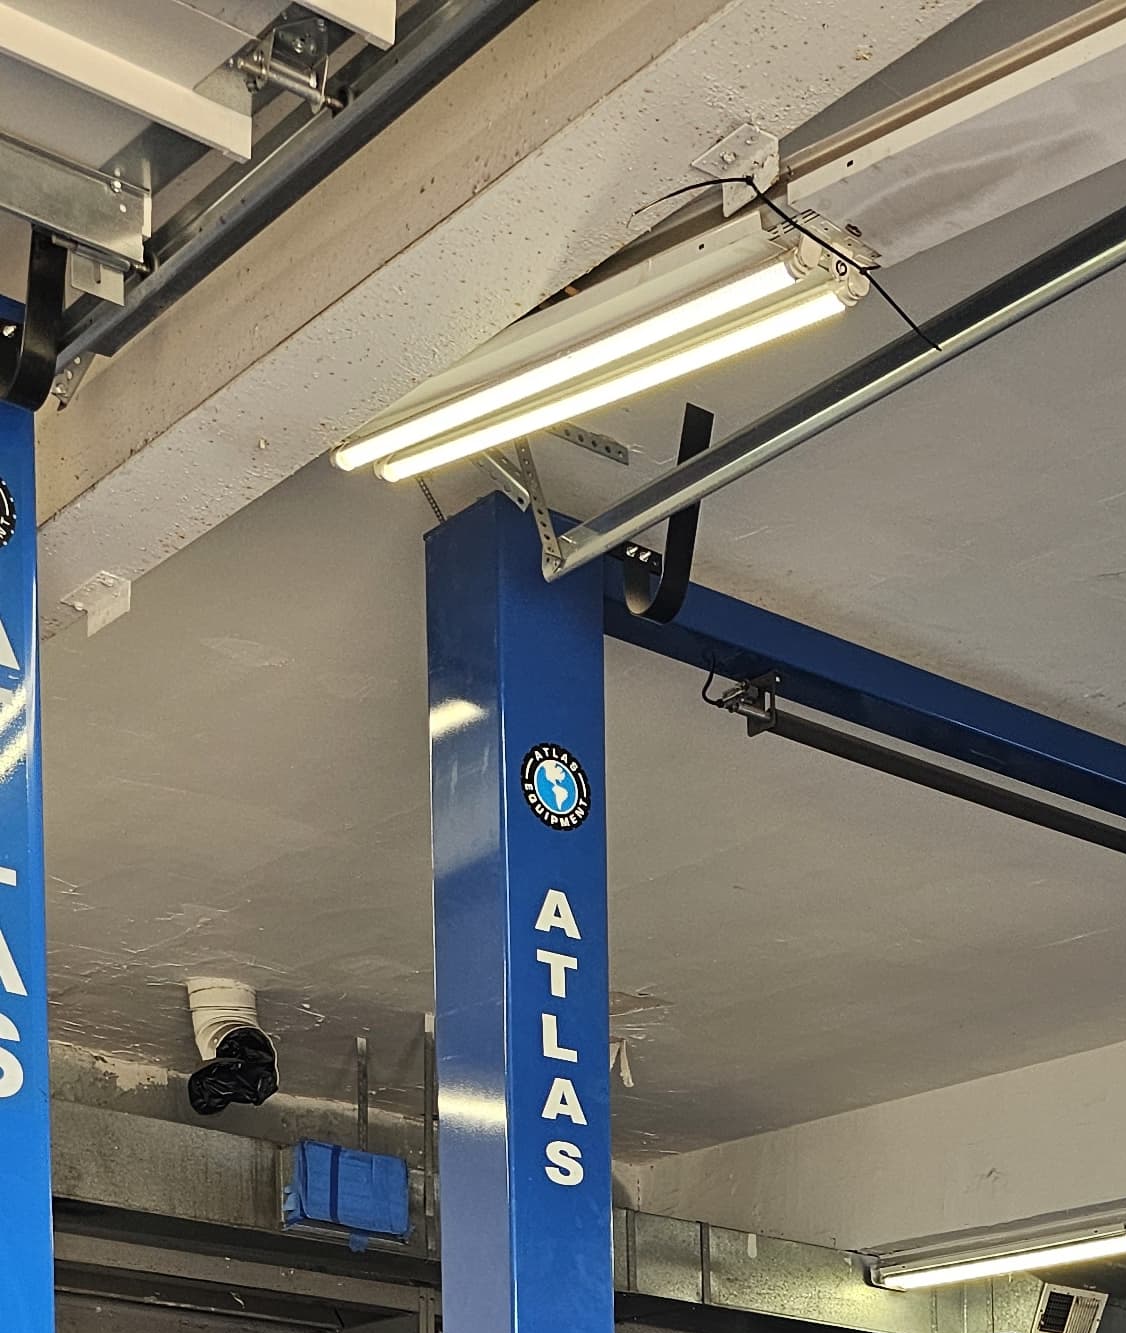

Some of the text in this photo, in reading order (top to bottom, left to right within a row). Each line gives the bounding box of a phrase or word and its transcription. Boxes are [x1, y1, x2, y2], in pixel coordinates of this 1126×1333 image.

[534, 747, 579, 772] ATLAS
[524, 783, 588, 826] EQUIPMENT
[535, 889, 588, 1186] ATLAS
